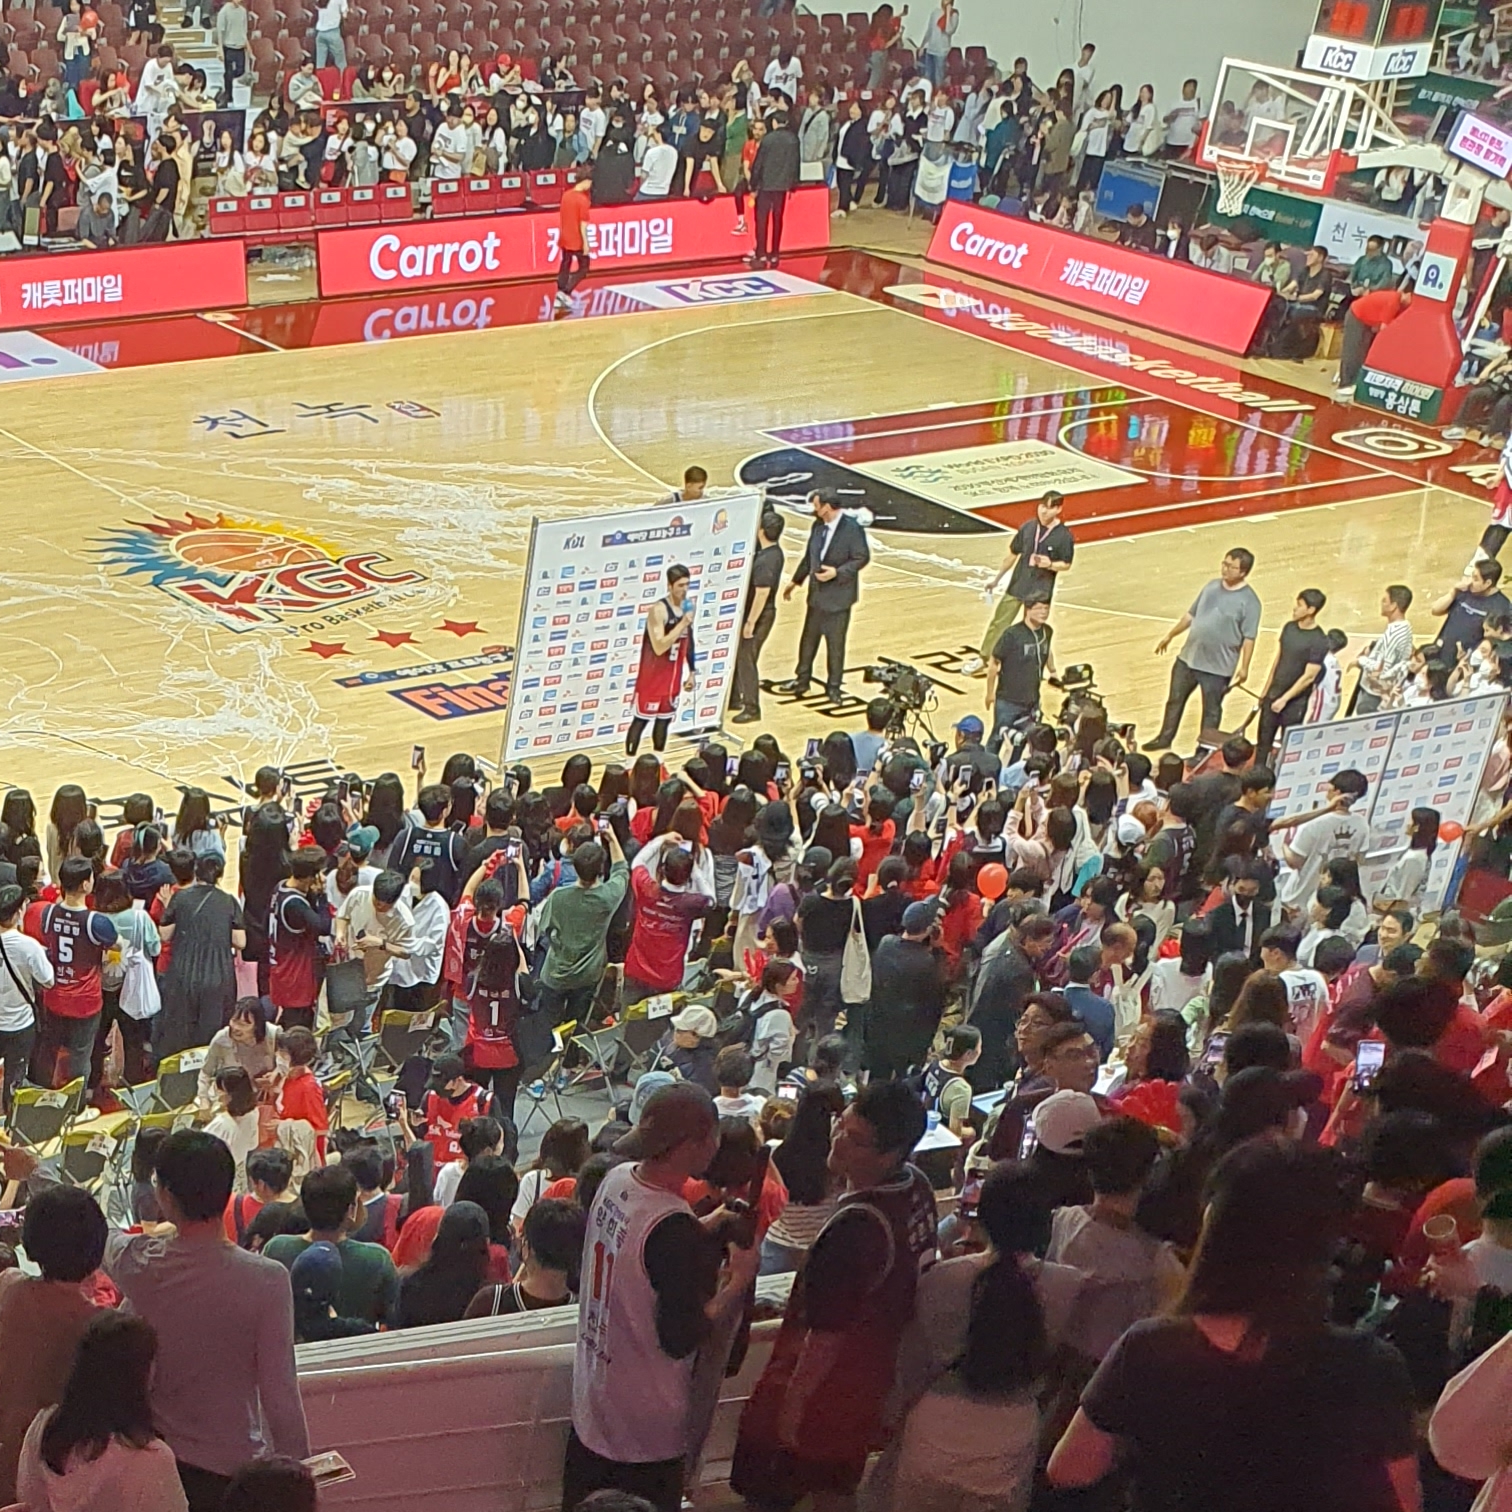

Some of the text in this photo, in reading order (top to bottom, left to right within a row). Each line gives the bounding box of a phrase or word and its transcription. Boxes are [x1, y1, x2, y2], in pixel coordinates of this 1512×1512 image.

[1324, 46, 1357, 73] KCC
[1386, 49, 1416, 75] KCC
[369, 230, 500, 281] Carrot
[949, 221, 1030, 270] Carrot
[21, 273, 124, 310] 캐롯퍼마일
[674, 276, 776, 302] KCC
[1059, 256, 1151, 306] 캐롯퍼마일
[158, 552, 430, 634] KGC
[58, 935, 74, 963] 5
[489, 1000, 500, 1027] 1
